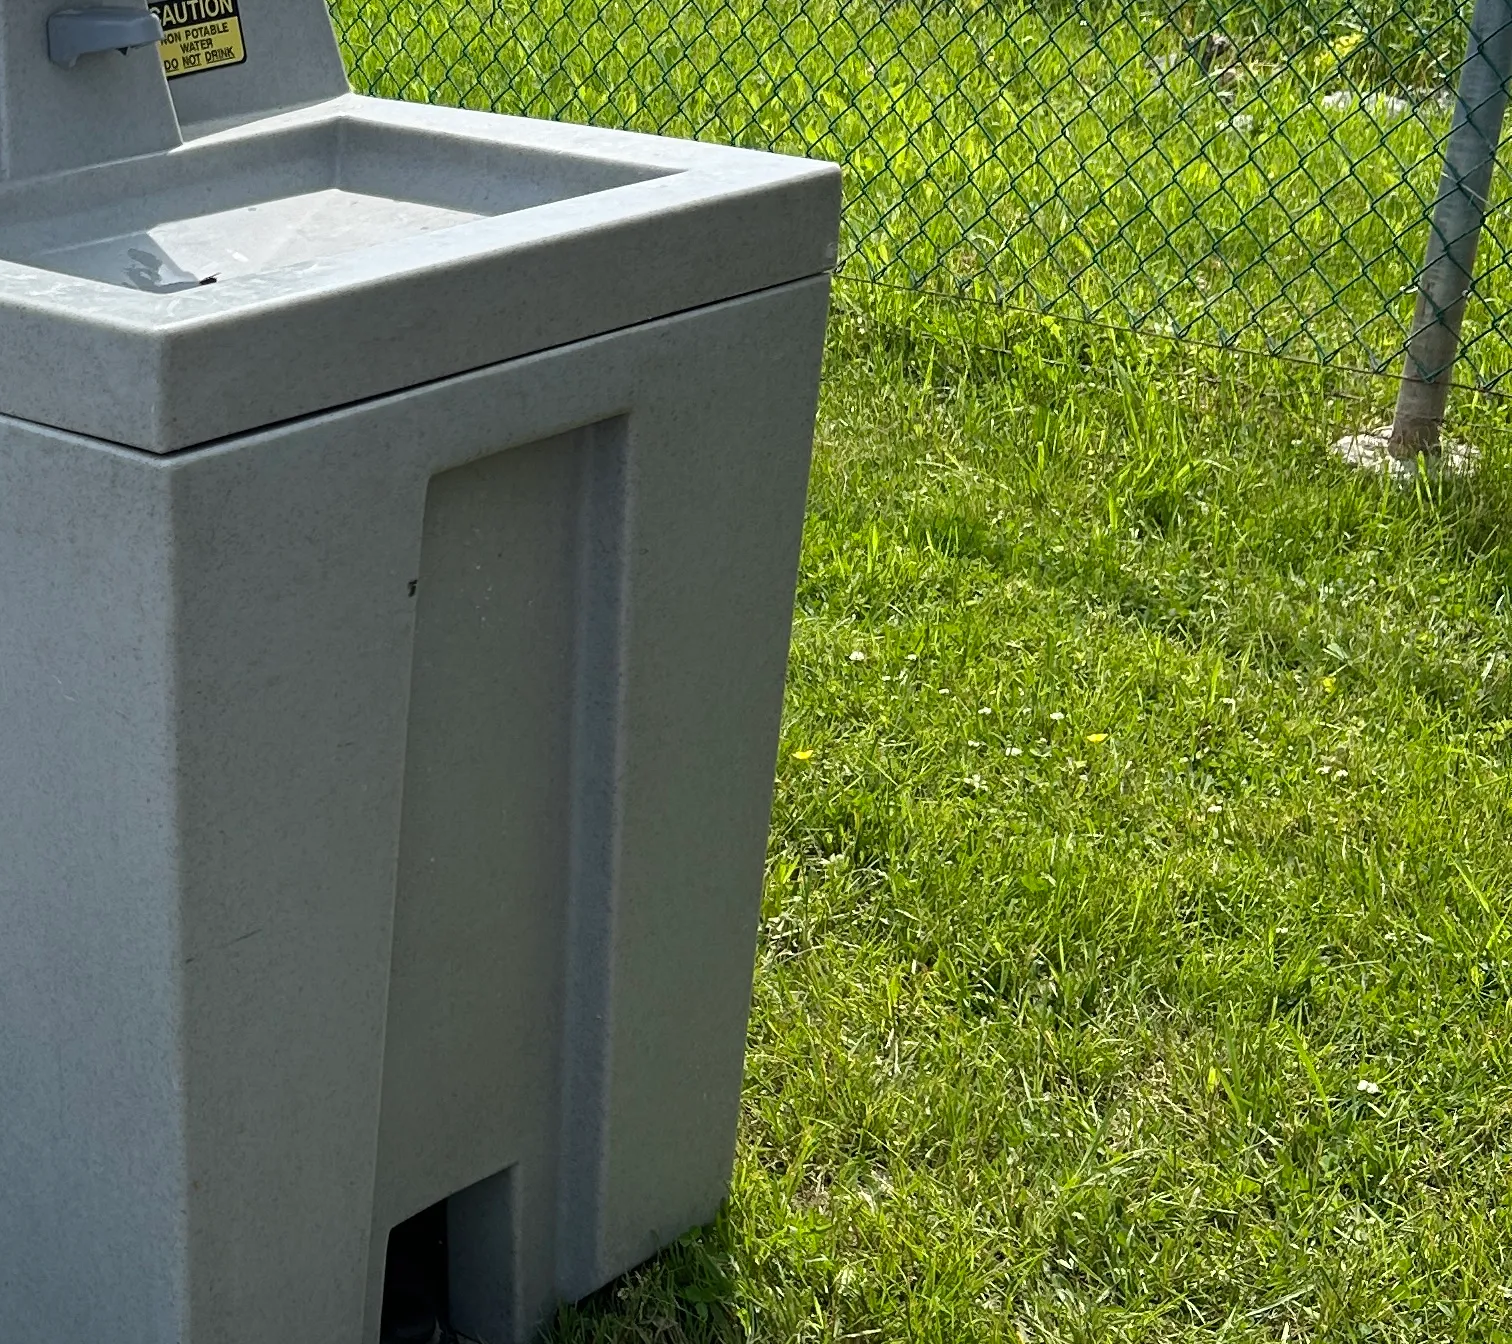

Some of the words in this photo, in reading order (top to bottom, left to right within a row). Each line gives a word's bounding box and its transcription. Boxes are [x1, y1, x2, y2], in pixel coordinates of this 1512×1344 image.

[185, 22, 230, 40] POTABLE
[180, 38, 214, 54] WATER
[164, 58, 179, 72] DO
[182, 53, 202, 69] NOT
[205, 47, 235, 63] DRINK
